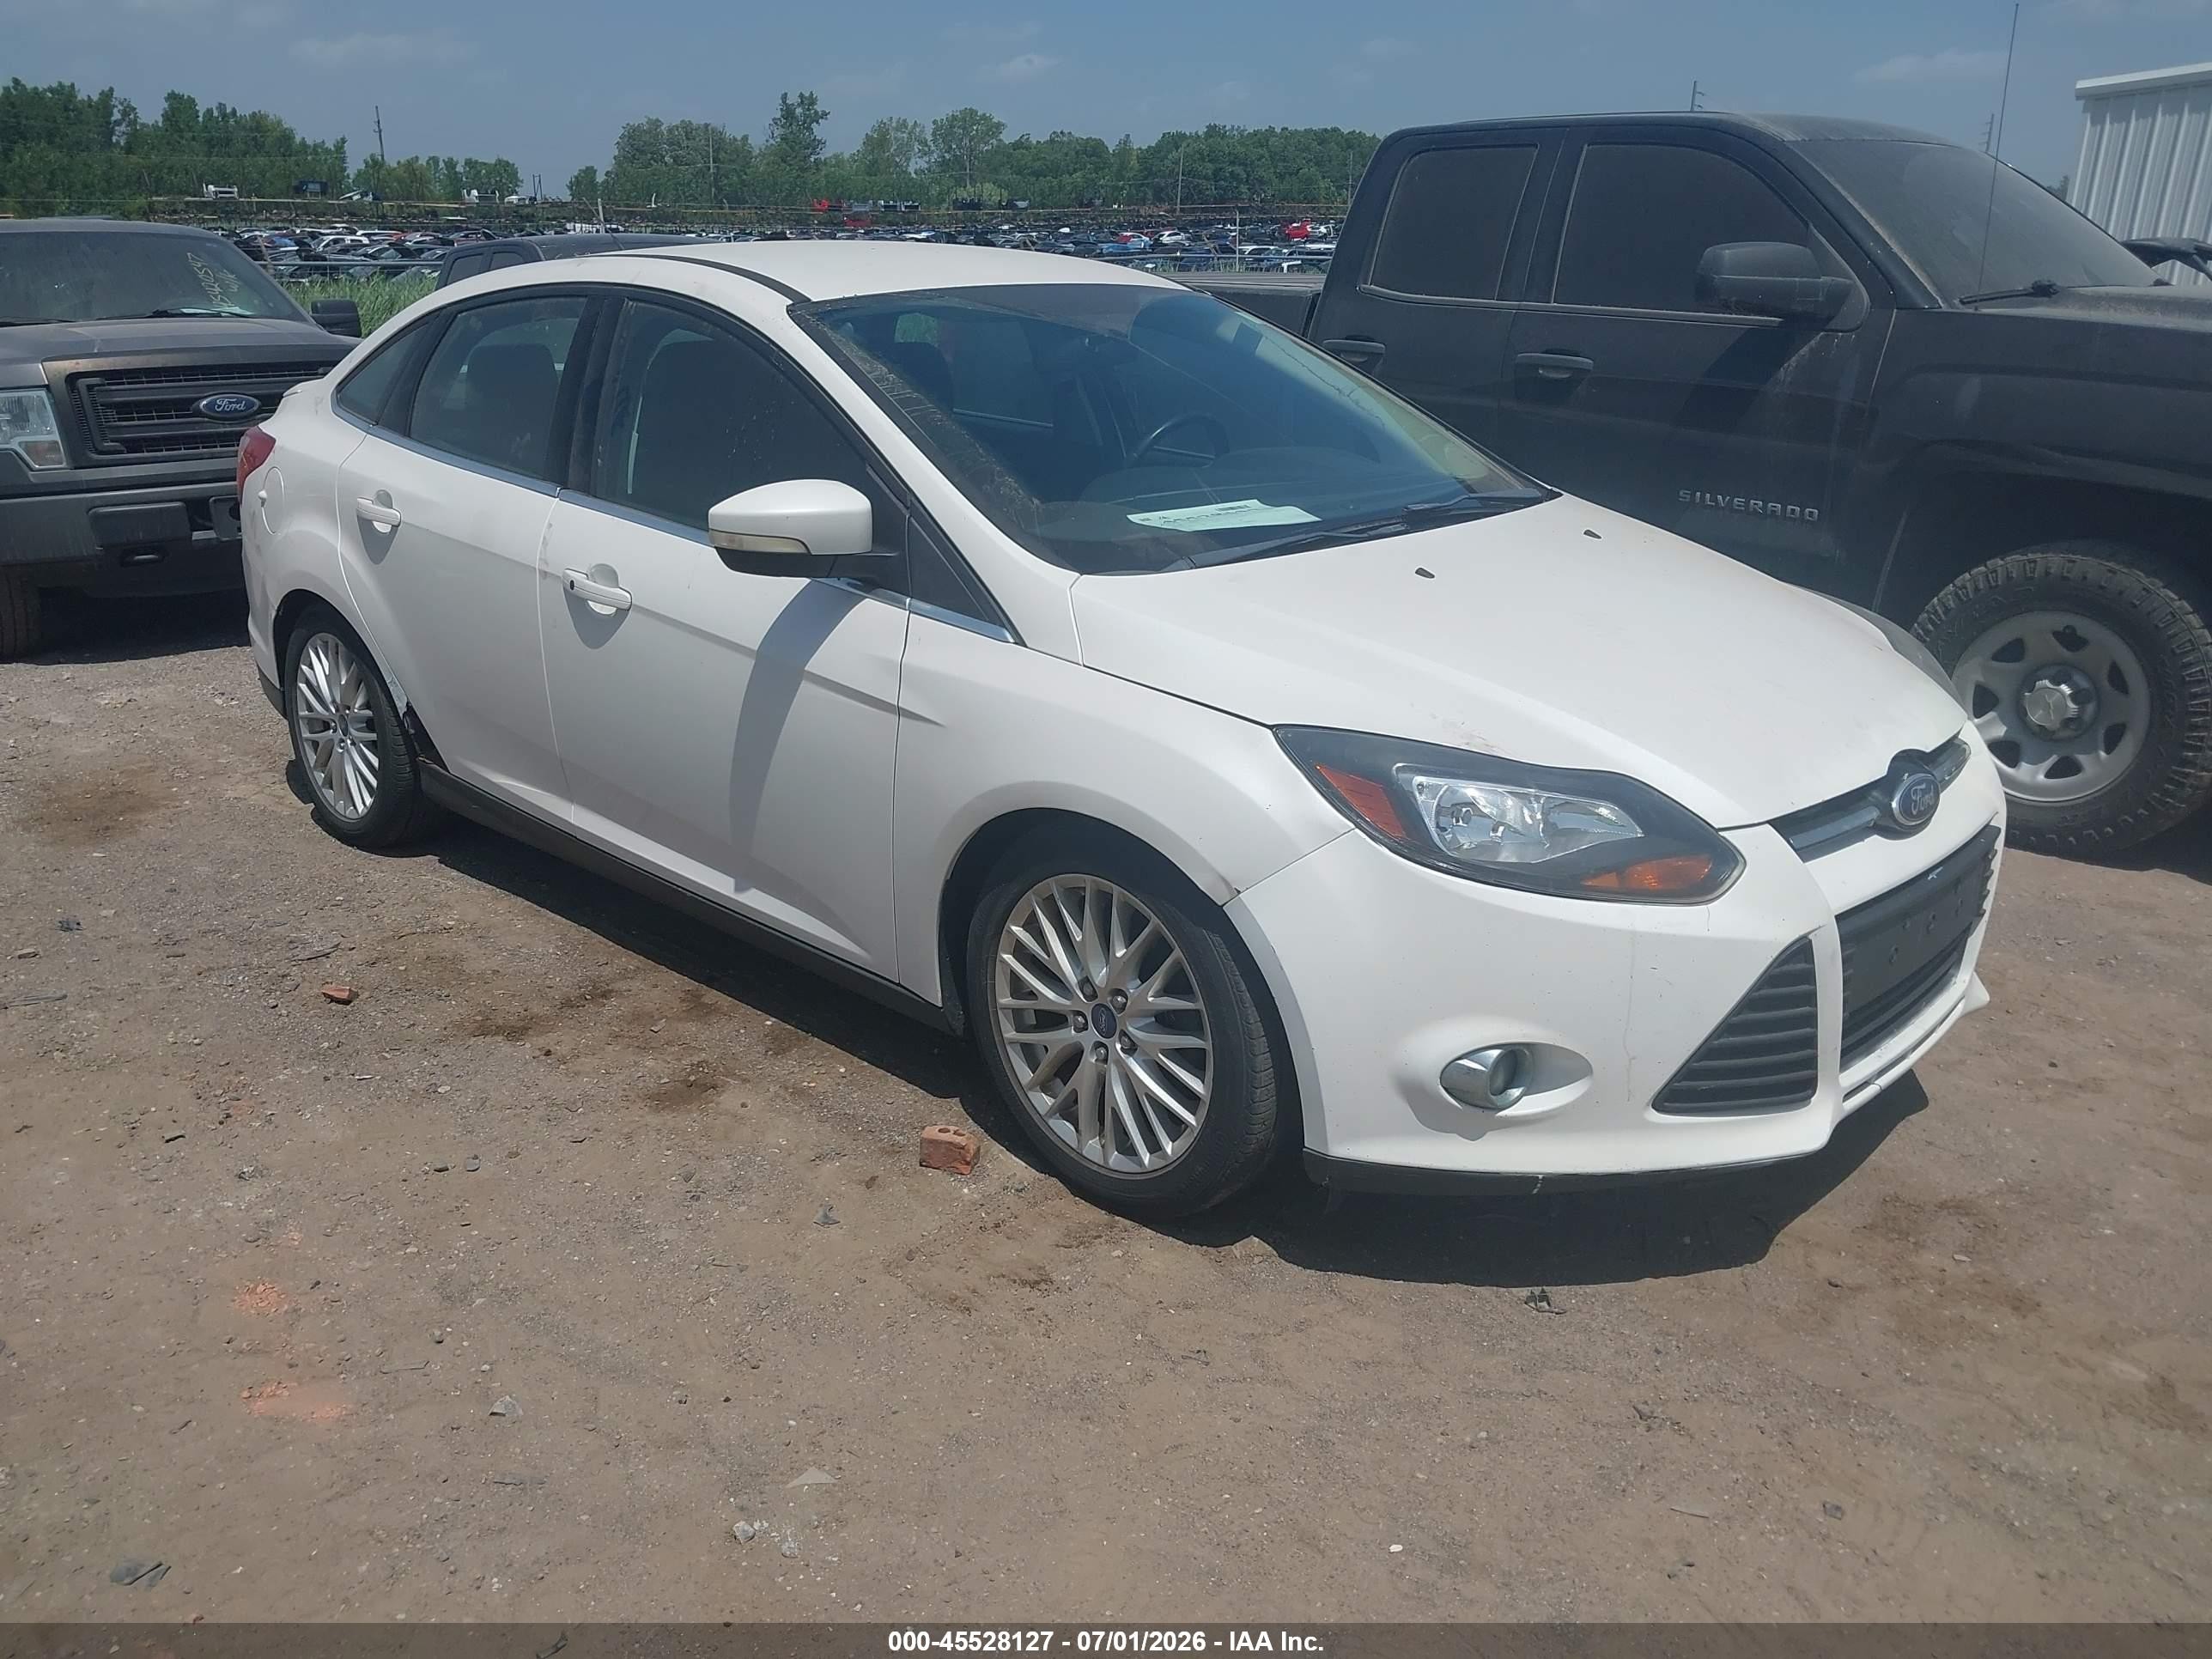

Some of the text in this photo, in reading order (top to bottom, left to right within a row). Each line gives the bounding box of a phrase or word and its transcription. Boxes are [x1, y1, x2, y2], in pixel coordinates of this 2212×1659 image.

[215, 398, 246, 411] Ford
[1678, 489, 1819, 521] SILVERADO
[1911, 782, 1935, 815] Ford
